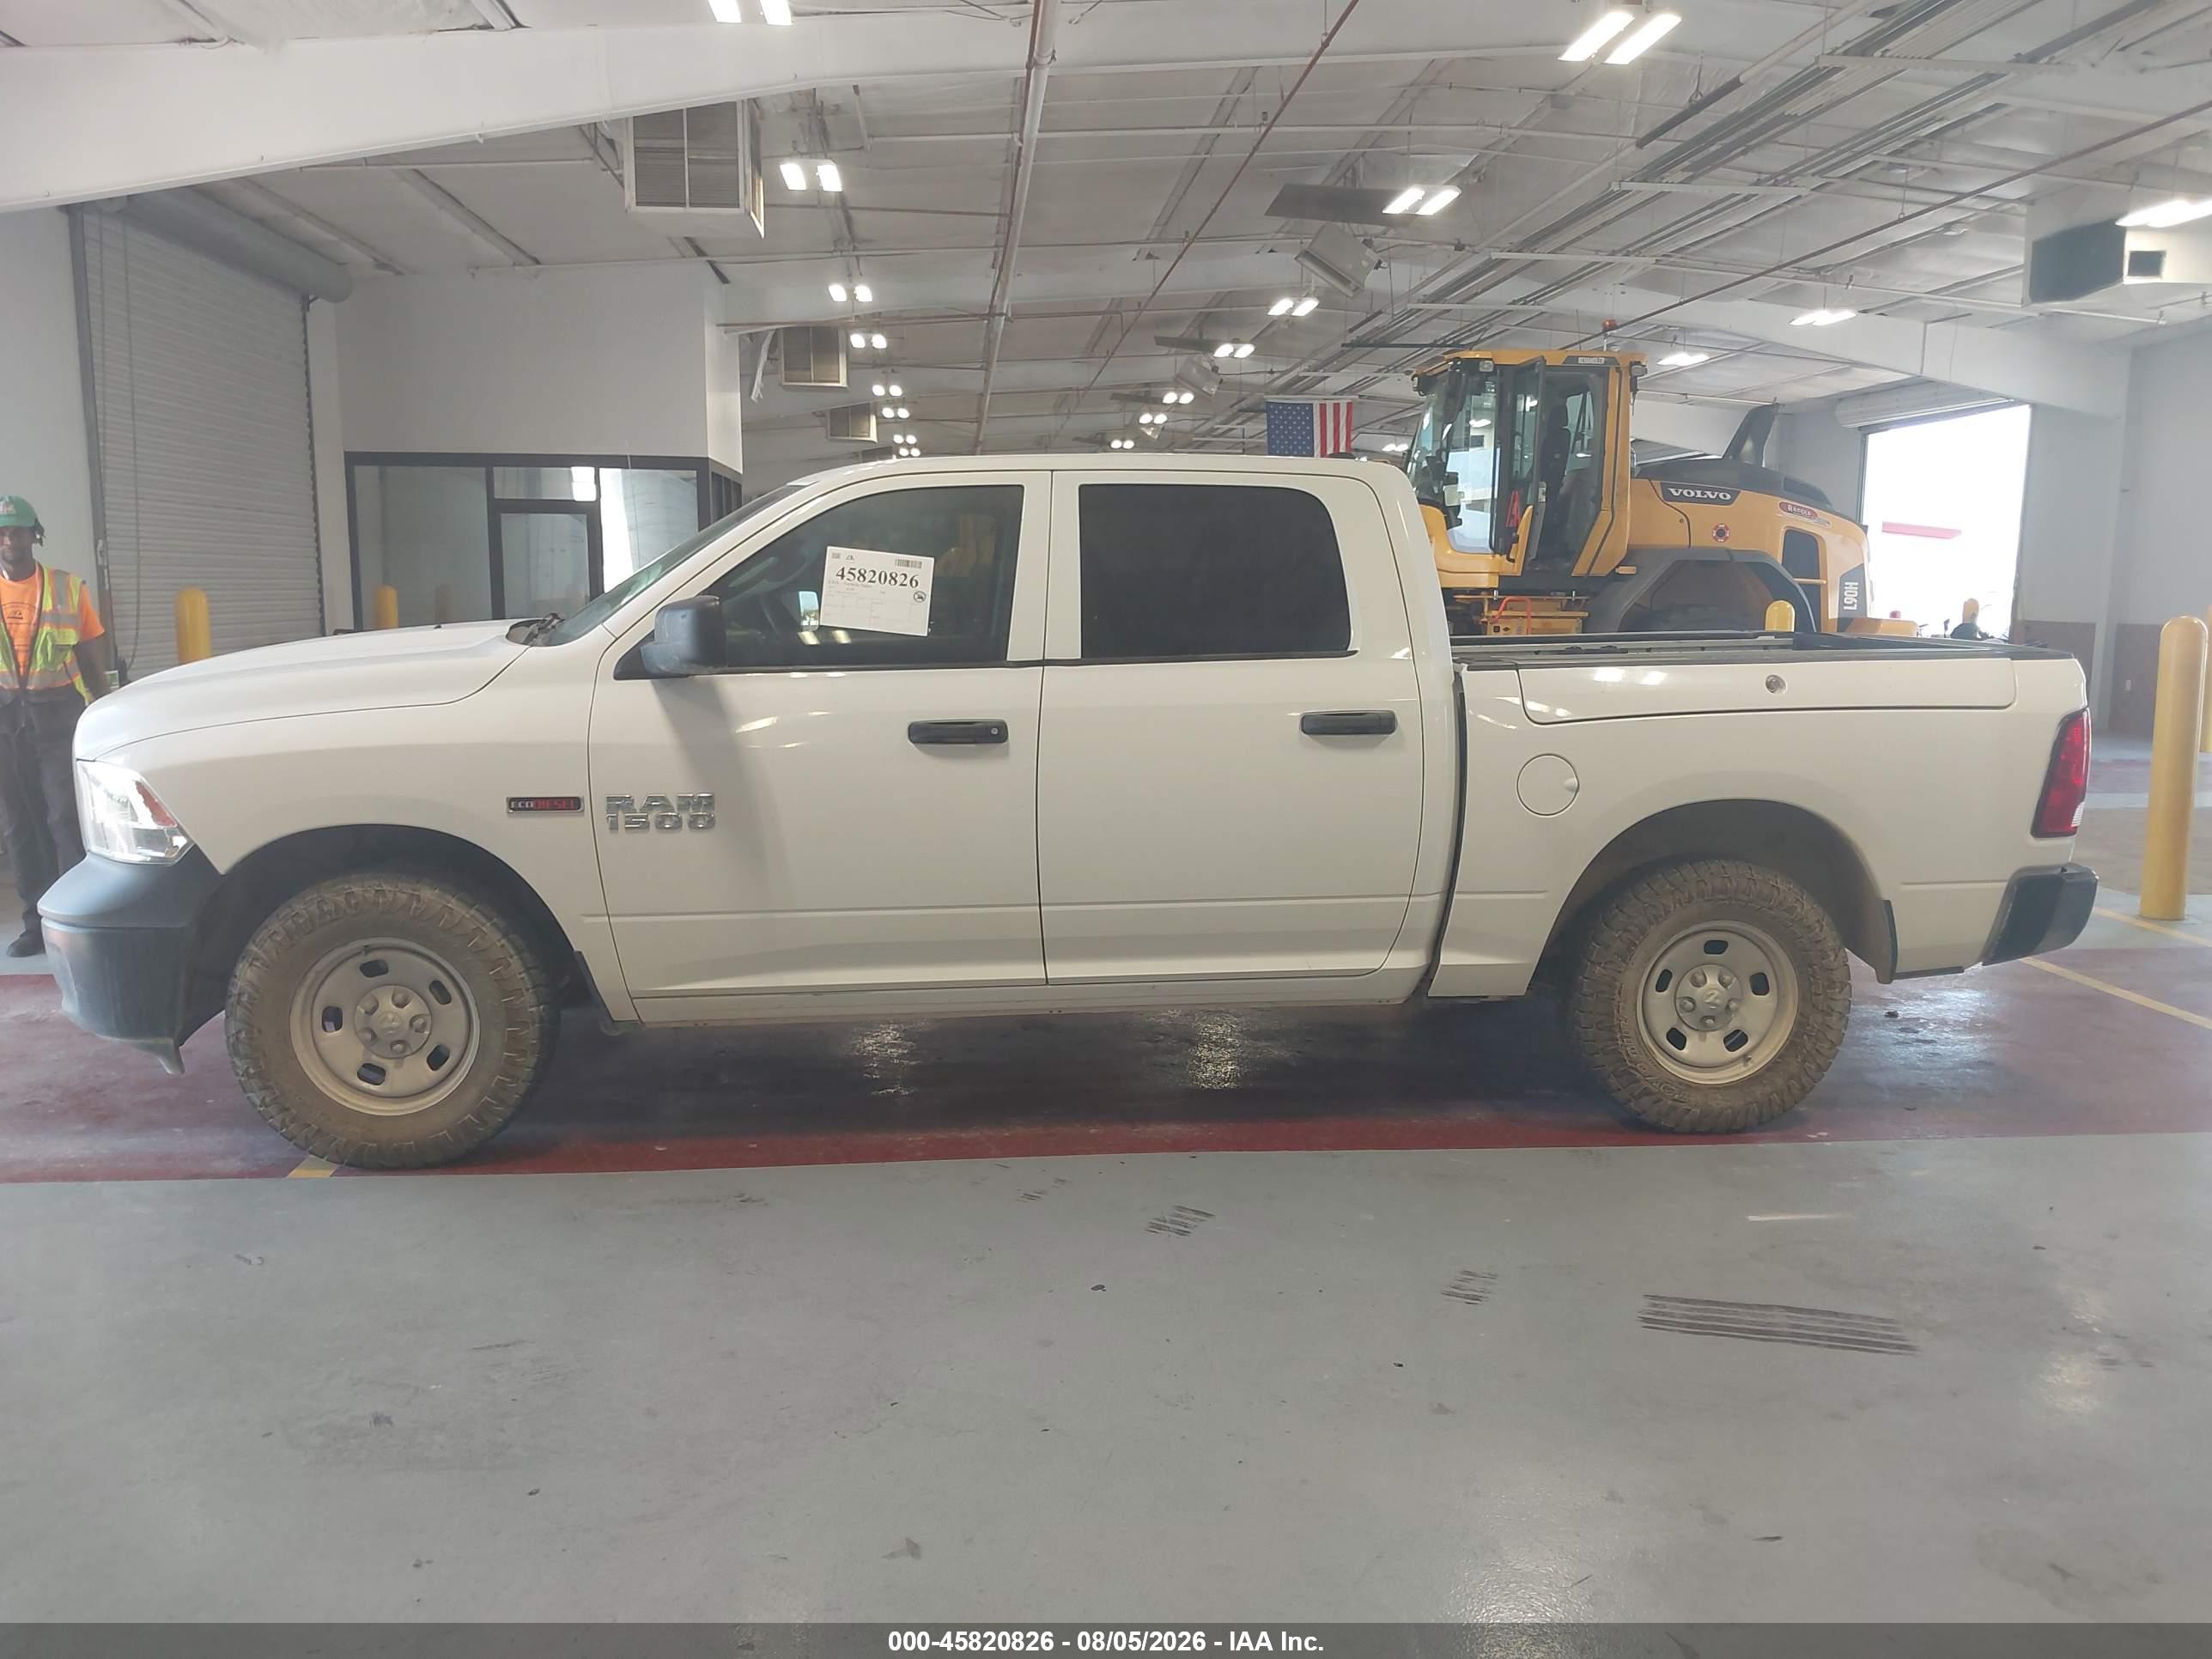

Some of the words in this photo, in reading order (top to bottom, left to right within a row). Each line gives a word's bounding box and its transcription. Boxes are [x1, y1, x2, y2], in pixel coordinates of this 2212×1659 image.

[1667, 488, 1731, 501] VOLVO
[836, 567, 920, 589] 45820826
[1843, 581, 1859, 611] L90H
[605, 793, 715, 813] RAM
[605, 812, 716, 831] 1500
